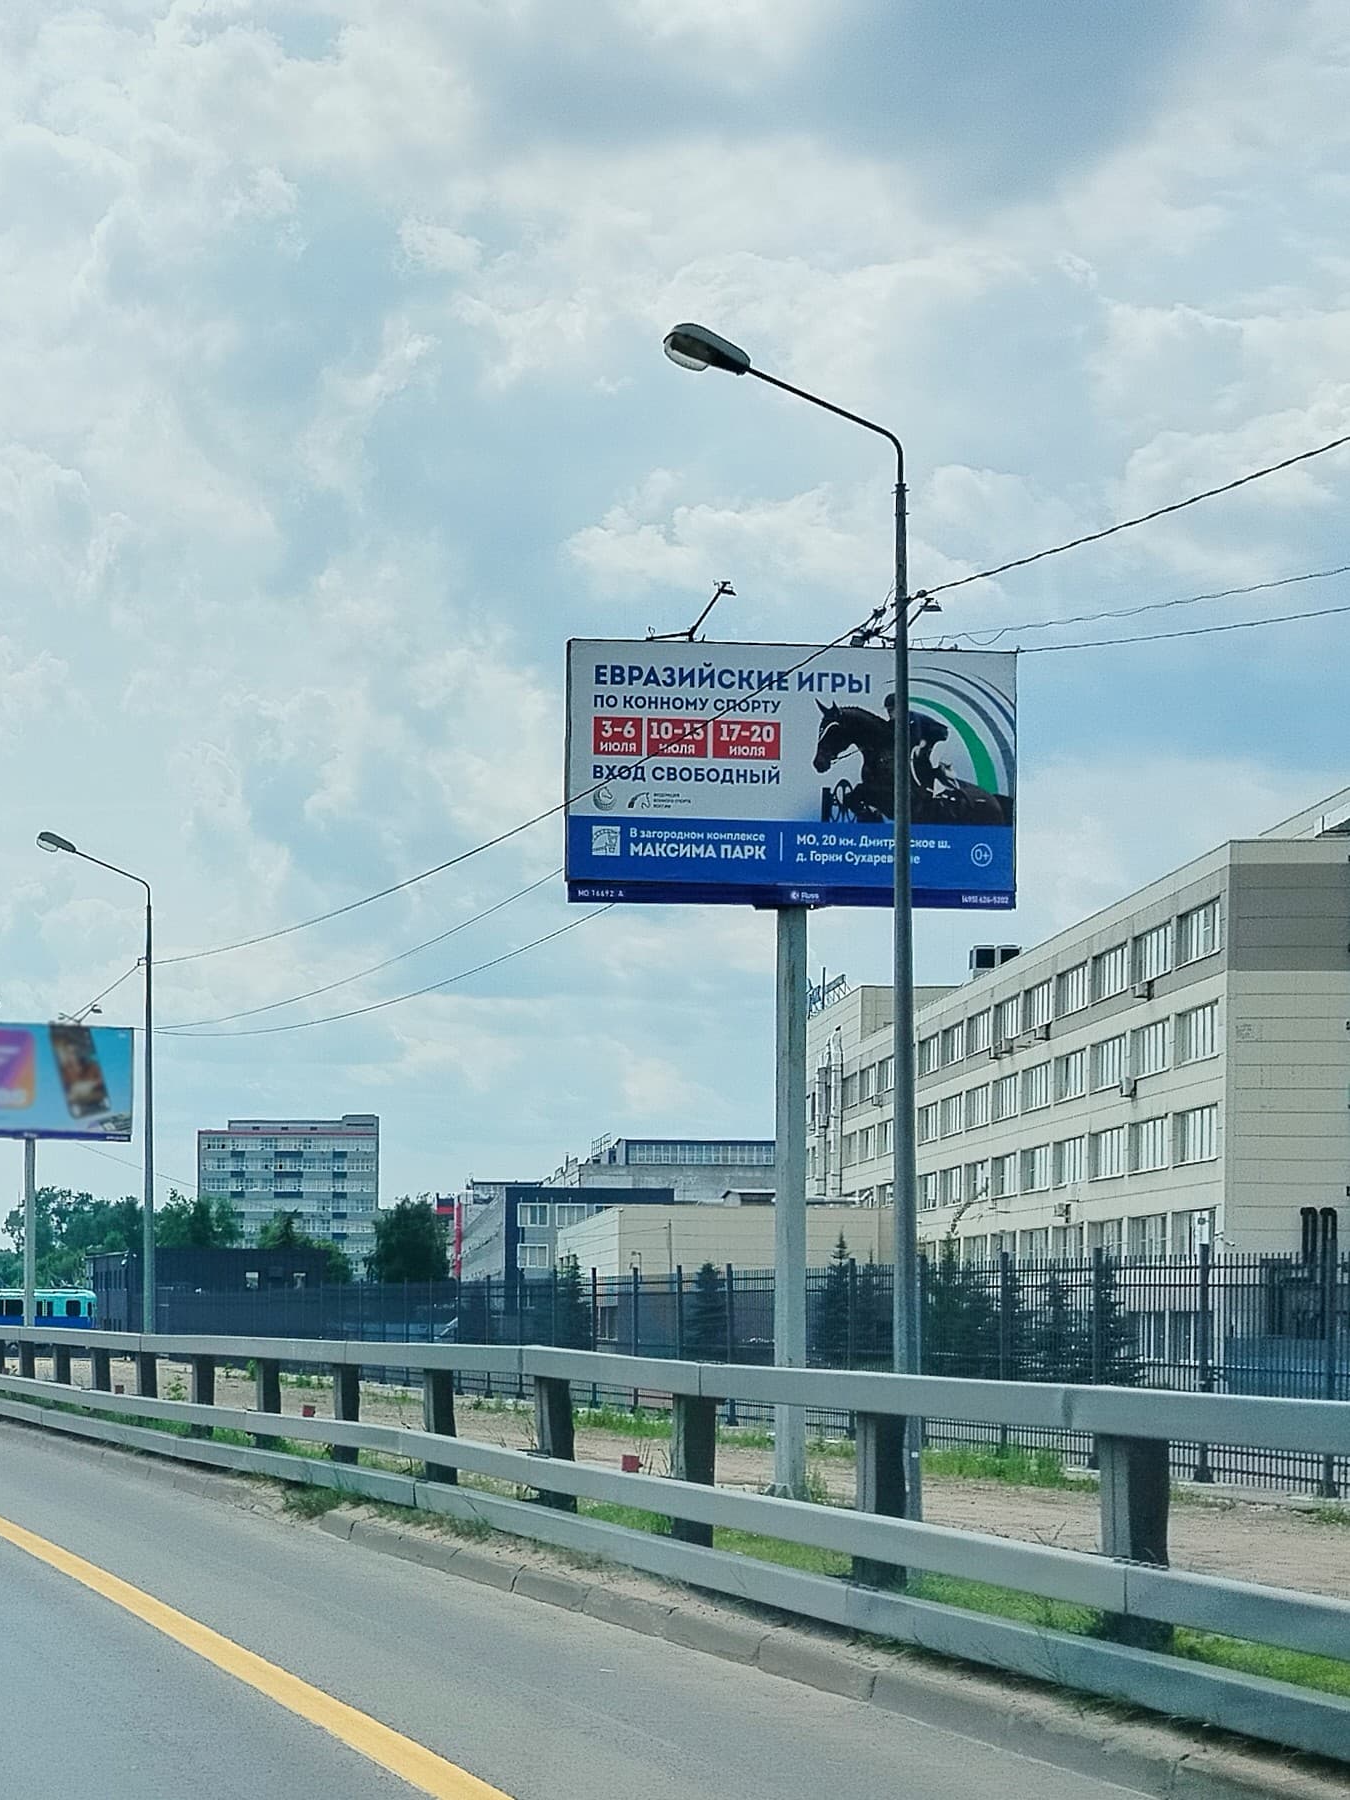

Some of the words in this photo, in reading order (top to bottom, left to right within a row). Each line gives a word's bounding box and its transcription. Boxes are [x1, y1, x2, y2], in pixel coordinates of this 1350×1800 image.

[594, 662, 789, 692] ЕВРАЗИЙСКИЕ
[797, 671, 871, 694] ИГРЫ
[593, 694, 618, 708] ПО
[623, 695, 709, 712] КОННОМУ
[713, 698, 782, 714] СПОРТУ
[601, 720, 636, 738] 3-6
[650, 722, 704, 741] 10-13
[720, 724, 775, 743] 17-20
[600, 741, 637, 753] ИЮЛЯ
[659, 743, 696, 755] ИЮЛЯ
[729, 745, 766, 757] ИЮЛЯ
[592, 764, 646, 782] ВХОД
[651, 765, 781, 785] СВОБОДНЫЙ
[629, 828, 638, 838] В
[640, 829, 704, 842] загородном
[706, 833, 766, 842] комплексе
[796, 835, 819, 847] МО,
[822, 836, 837, 847] 20
[839, 838, 857, 847] км.
[859, 838, 936, 850] Дмитрское
[938, 840, 951, 849] ш.
[629, 842, 717, 859] МАКСИМА
[720, 845, 767, 860] ПАРК
[796, 853, 807, 863] д.
[809, 852, 842, 863] Горки
[974, 848, 989, 861] 0+
